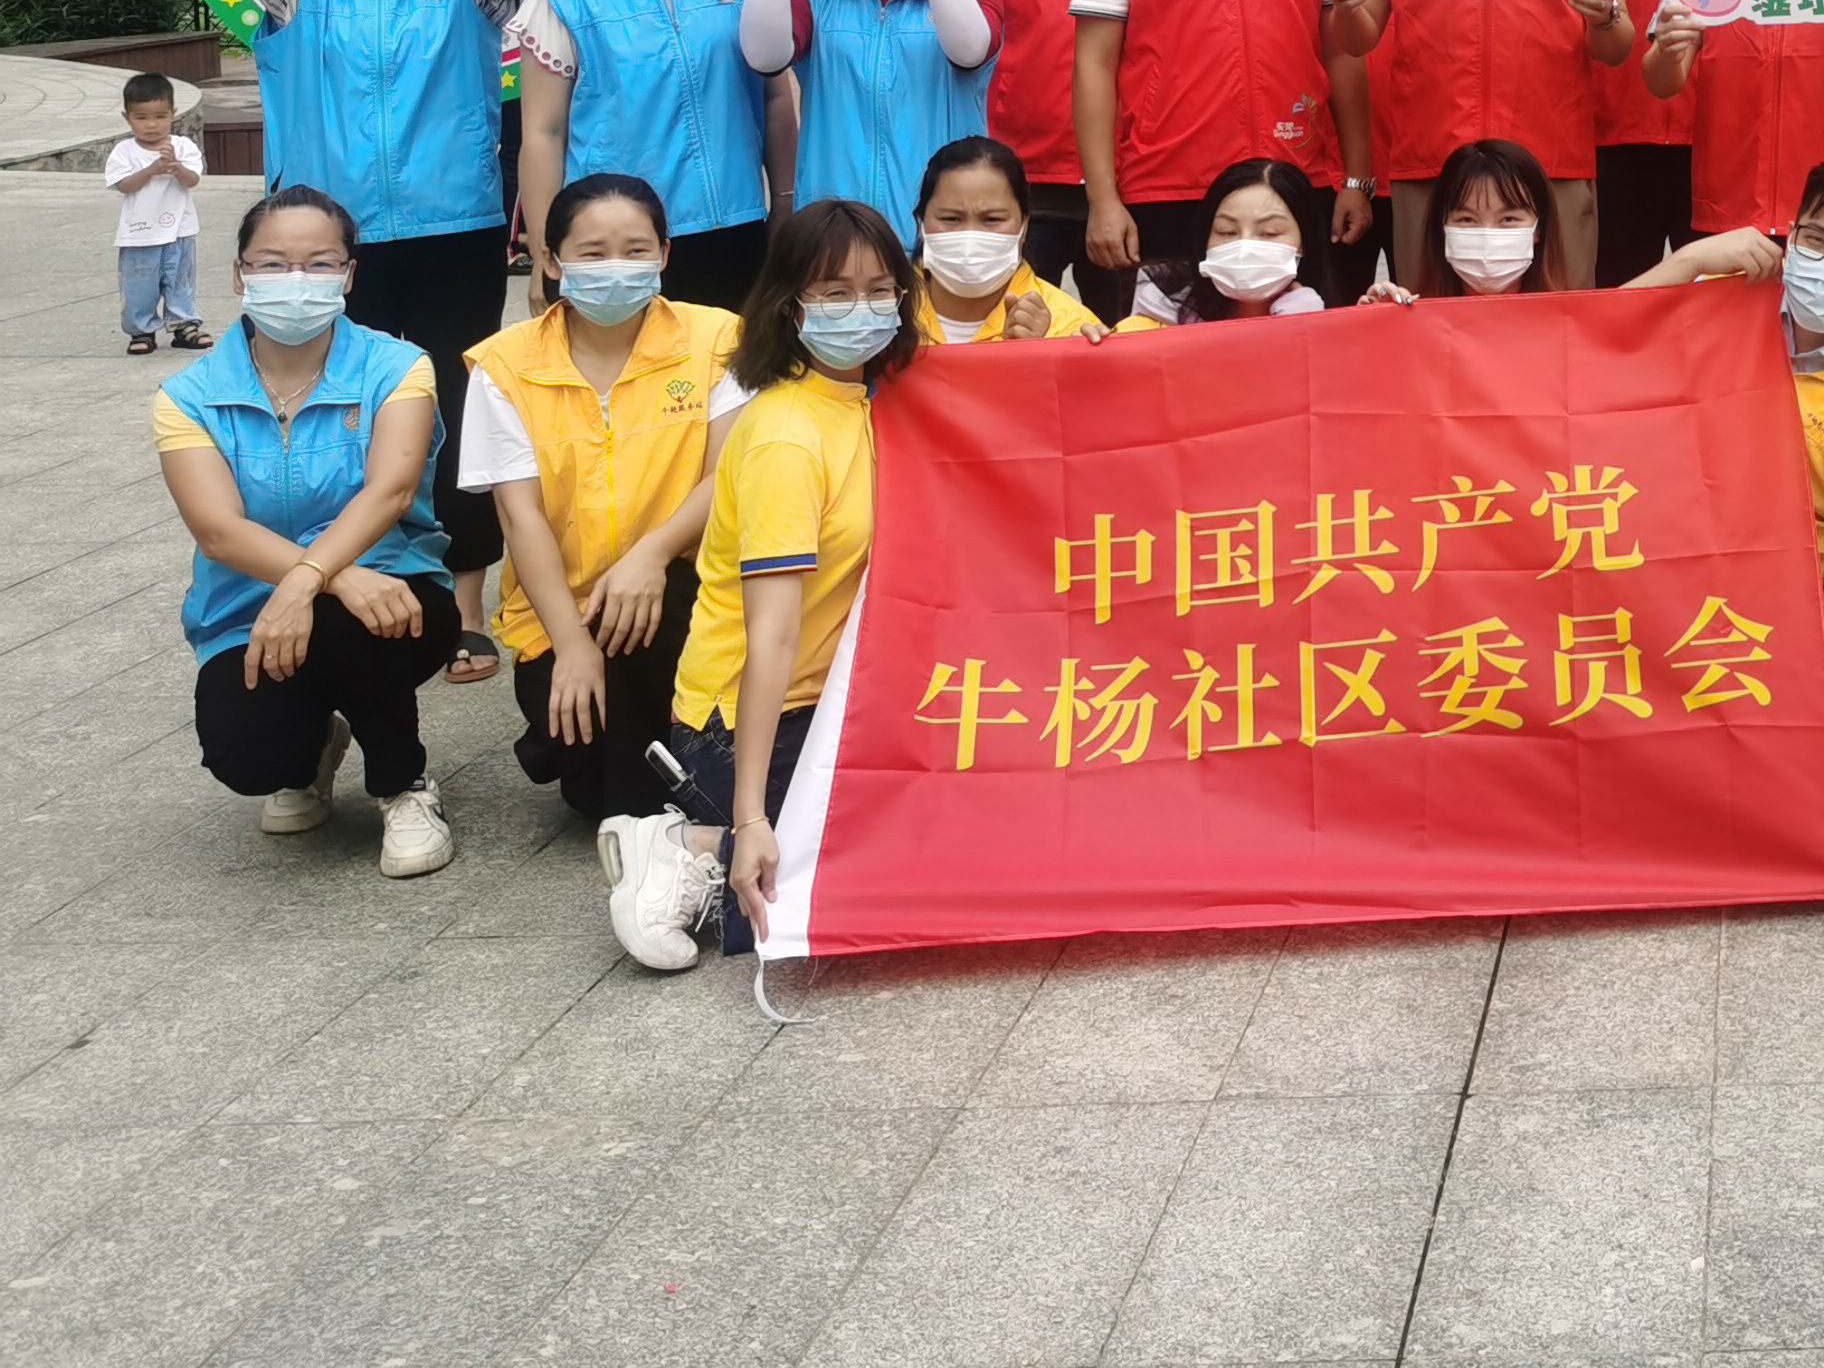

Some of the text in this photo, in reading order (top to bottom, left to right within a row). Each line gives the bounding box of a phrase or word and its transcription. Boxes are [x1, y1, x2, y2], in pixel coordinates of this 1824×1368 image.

[1053, 464, 1645, 625] 中国共产党
[913, 595, 1775, 772] 牛杨社区委员会
